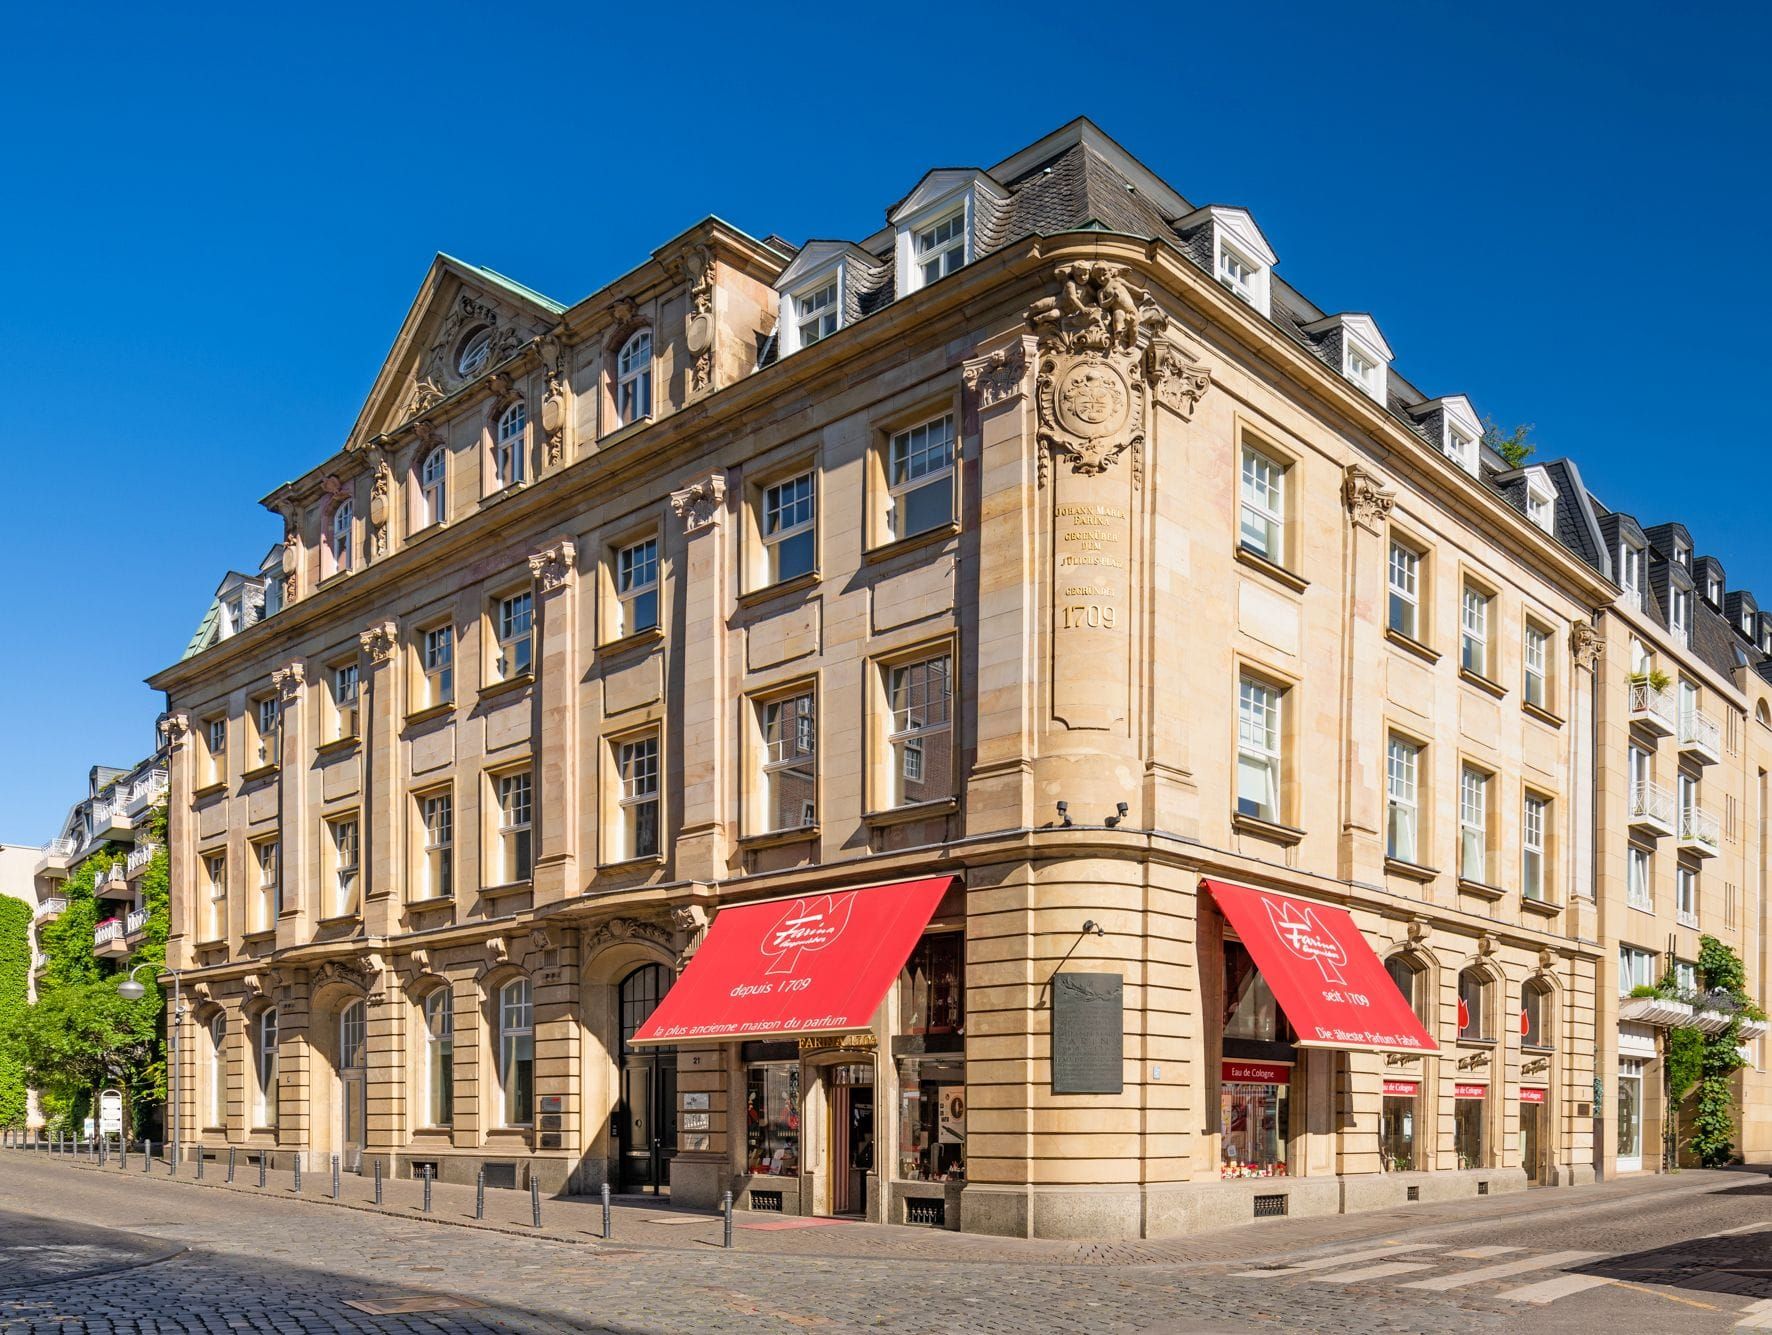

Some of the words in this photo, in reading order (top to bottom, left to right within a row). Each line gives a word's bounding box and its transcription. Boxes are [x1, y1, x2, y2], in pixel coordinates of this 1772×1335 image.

[1055, 506, 1093, 518] JOHANN
[1073, 516, 1110, 526] FARINA
[1062, 605, 1116, 629] 1709
[773, 914, 835, 946] Farina
[1278, 921, 1337, 952] Farina
[730, 981, 774, 998] depuis
[778, 977, 812, 993] 1709
[1322, 989, 1345, 1003] seit
[1344, 992, 1370, 1007] 1709
[653, 1025, 664, 1037] la
[664, 1025, 686, 1038] plus
[689, 1022, 738, 1034] ancienne
[741, 1019, 781, 1031] maison
[784, 1016, 800, 1029] du
[802, 1015, 848, 1030] parfum
[1315, 1026, 1334, 1040] Die
[692, 1056, 700, 1065] 21
[1231, 1067, 1242, 1077] Eau
[1243, 1068, 1251, 1077] de
[1251, 1068, 1274, 1079] Cologne
